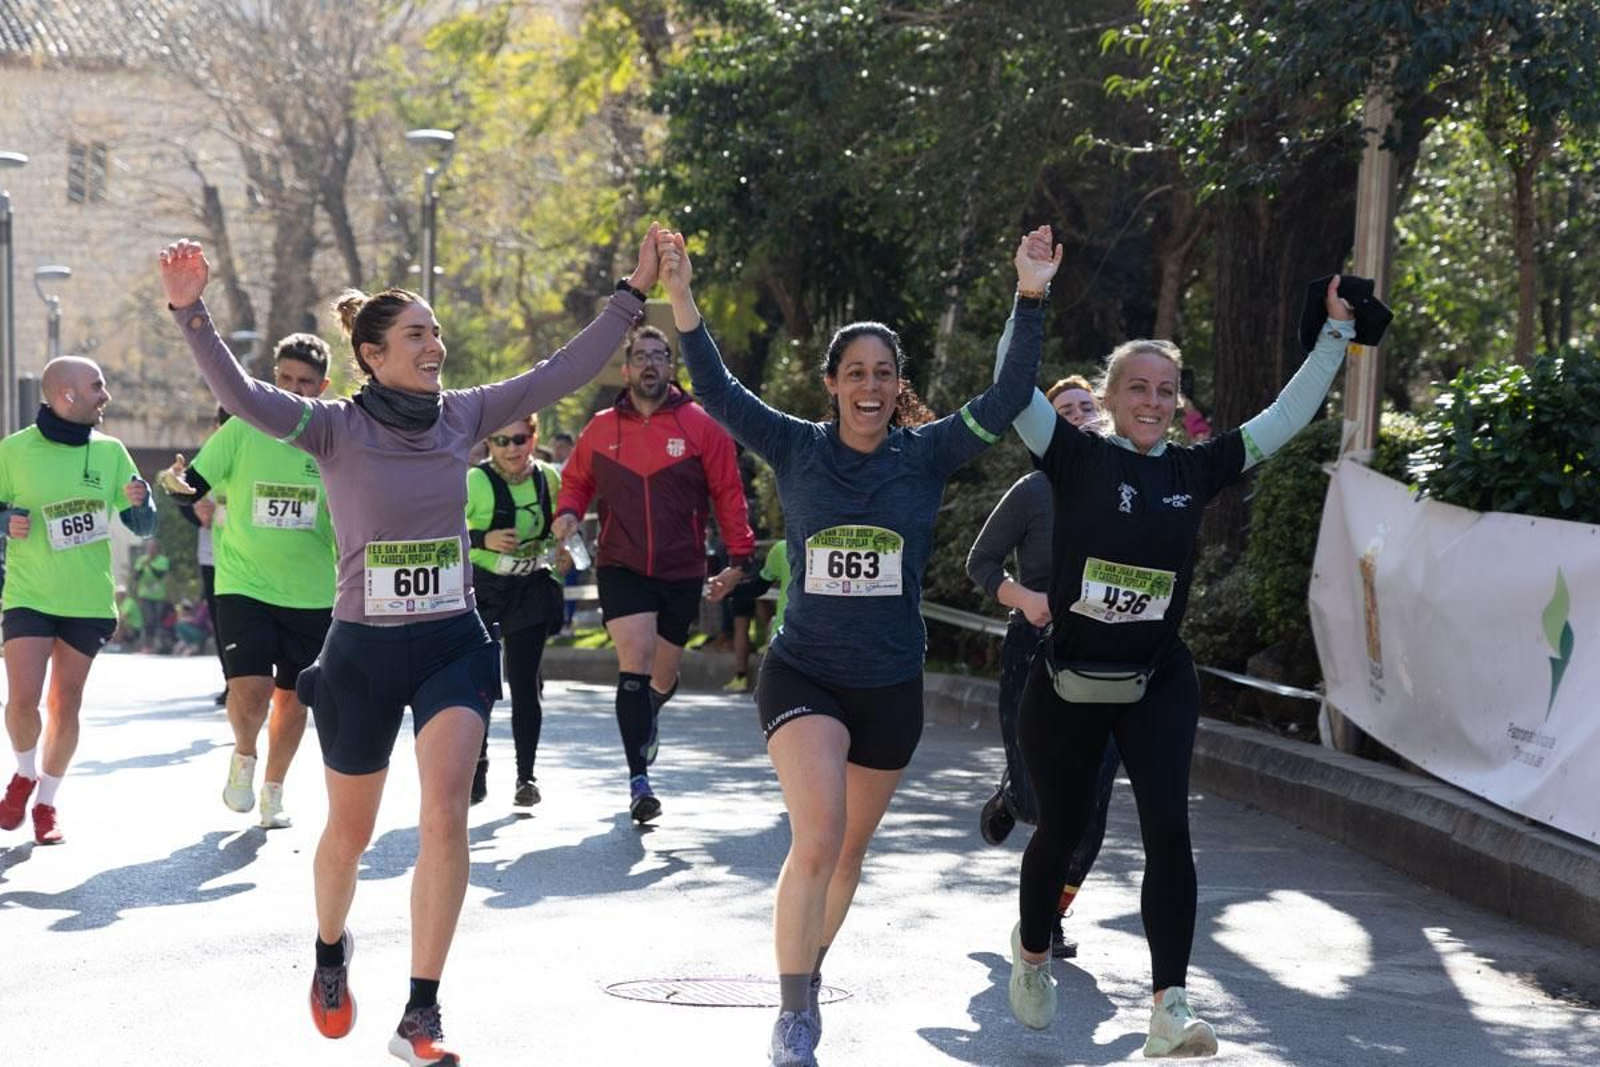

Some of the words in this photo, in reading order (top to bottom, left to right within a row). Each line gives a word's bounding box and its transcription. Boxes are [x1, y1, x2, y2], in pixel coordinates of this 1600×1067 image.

[268, 499, 301, 517] 574
[61, 513, 94, 536] 669
[824, 529, 837, 537] SAN
[838, 528, 854, 537] JUAN
[384, 543, 398, 554] SAN
[400, 543, 417, 554] JUAN
[418, 543, 436, 553] BOSCO
[820, 536, 844, 548] CARRERA
[845, 538, 869, 549] POPULAR
[381, 554, 406, 565] CARRERA
[408, 553, 433, 565] POPULAR
[828, 550, 880, 580] 663
[394, 566, 440, 597] 601
[1102, 586, 1152, 615] 436
[767, 705, 812, 731] LURBEL
